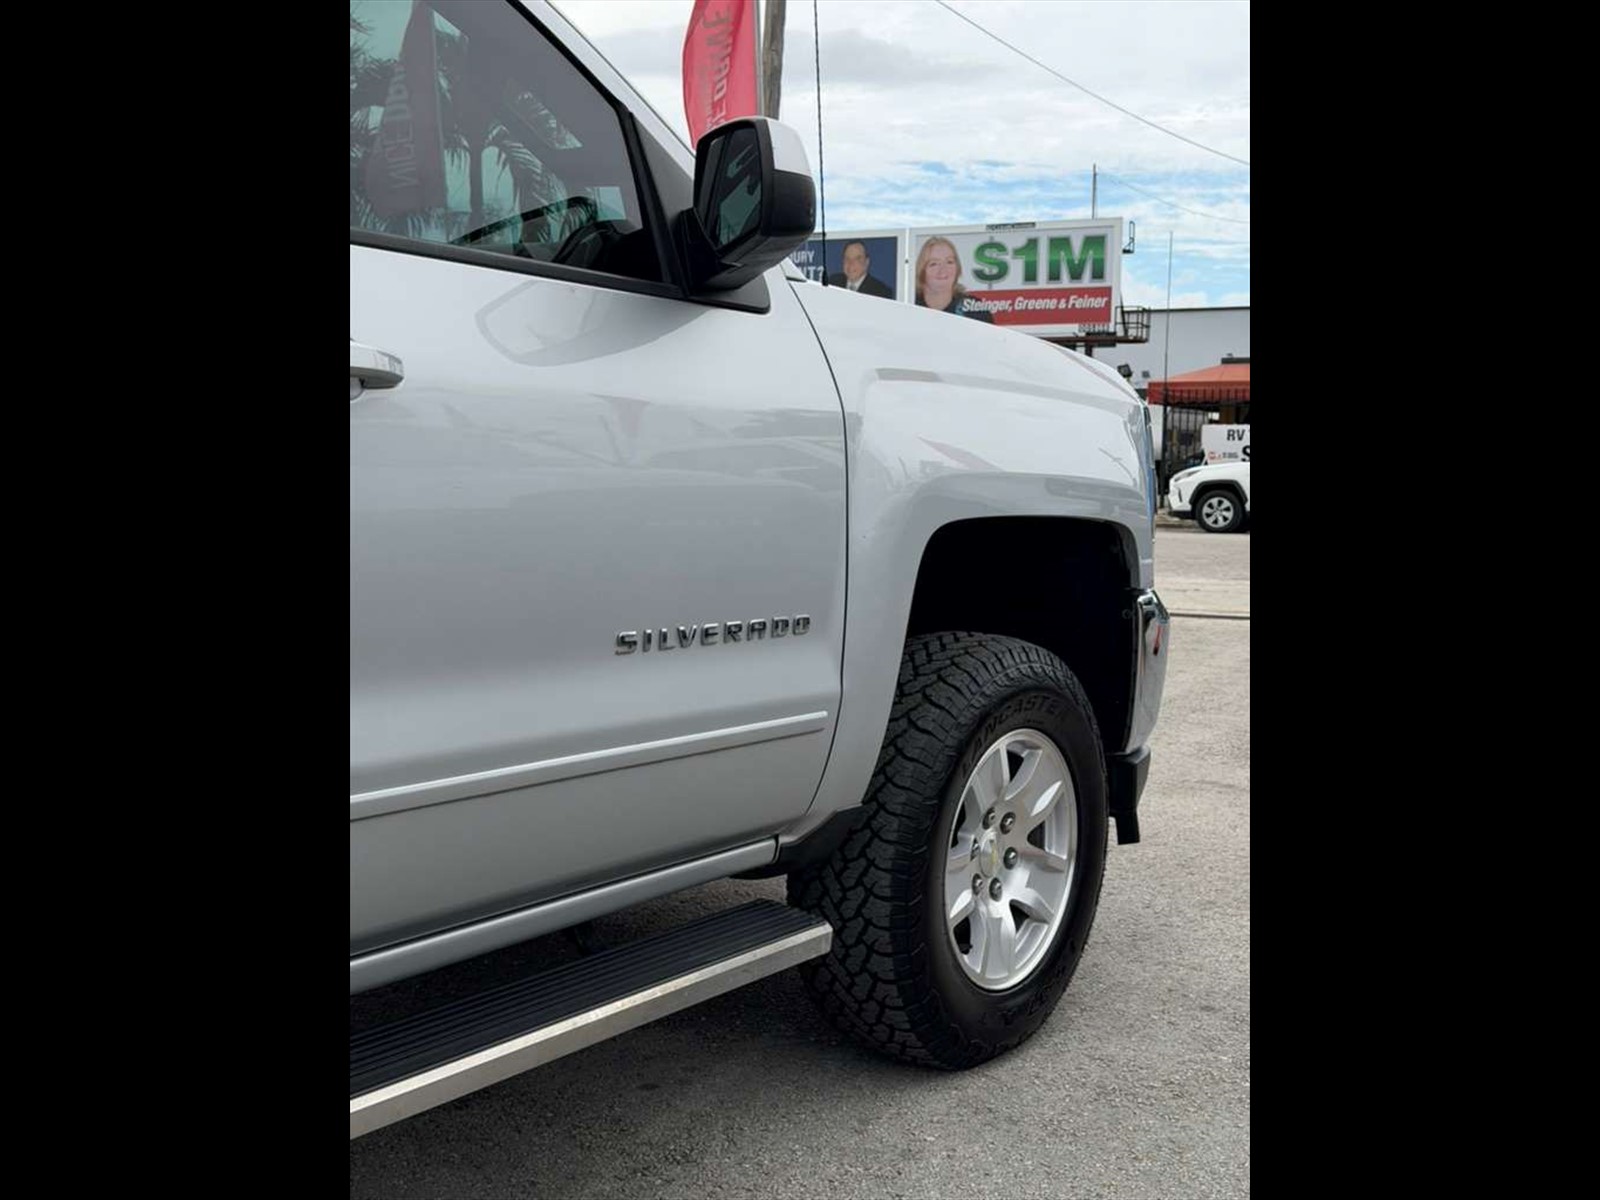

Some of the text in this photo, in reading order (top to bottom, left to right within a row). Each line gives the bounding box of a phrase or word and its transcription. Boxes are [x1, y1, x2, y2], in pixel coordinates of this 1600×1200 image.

[790, 249, 815, 263] URY
[972, 233, 1108, 289] $1M
[962, 294, 1109, 313] Steinger, Greene & Feiner
[1226, 428, 1246, 442] RV
[614, 613, 811, 656] SILVERADO
